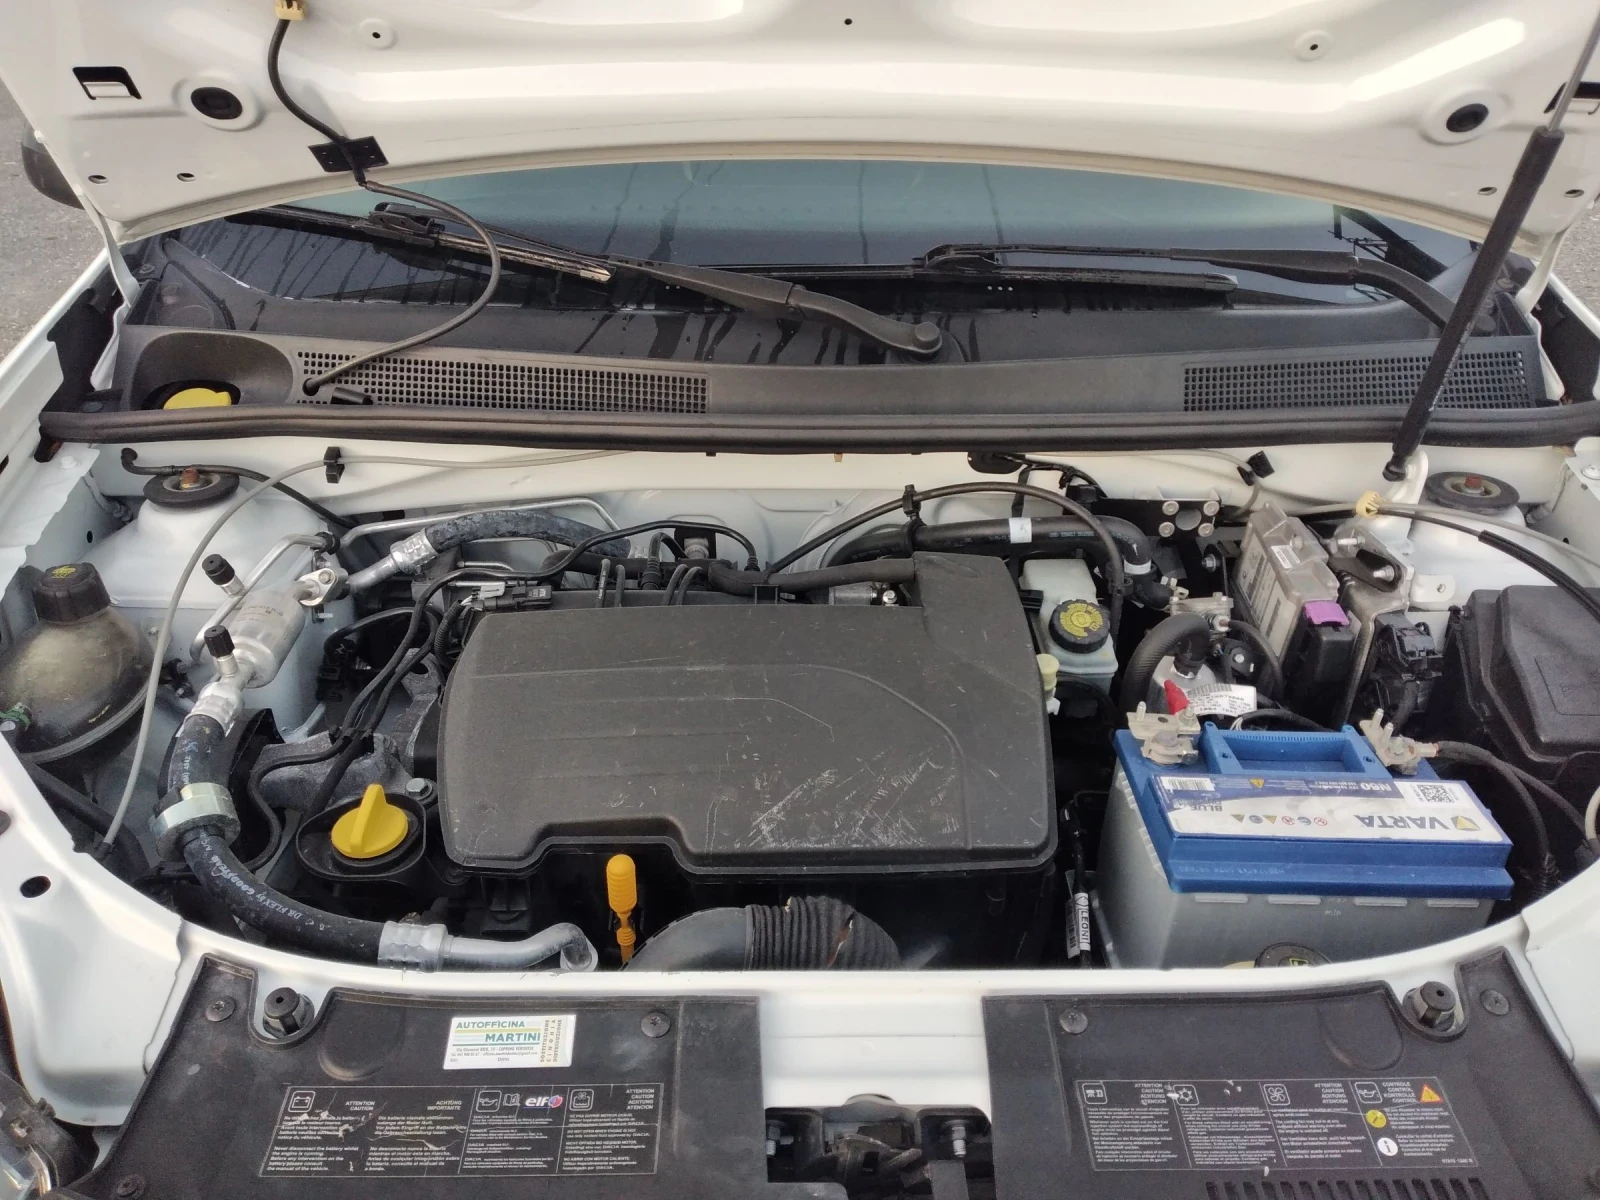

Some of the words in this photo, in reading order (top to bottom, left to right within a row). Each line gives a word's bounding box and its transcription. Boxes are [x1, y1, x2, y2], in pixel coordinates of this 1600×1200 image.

[1360, 782, 1392, 792] N60
[1353, 814, 1450, 830] VARTA
[264, 898, 289, 914] FLEX
[1080, 910, 1089, 941] LEONI
[456, 1020, 525, 1028] AUTOFFICINA
[485, 1033, 540, 1042] MARTINI
[526, 1096, 548, 1106] elf
